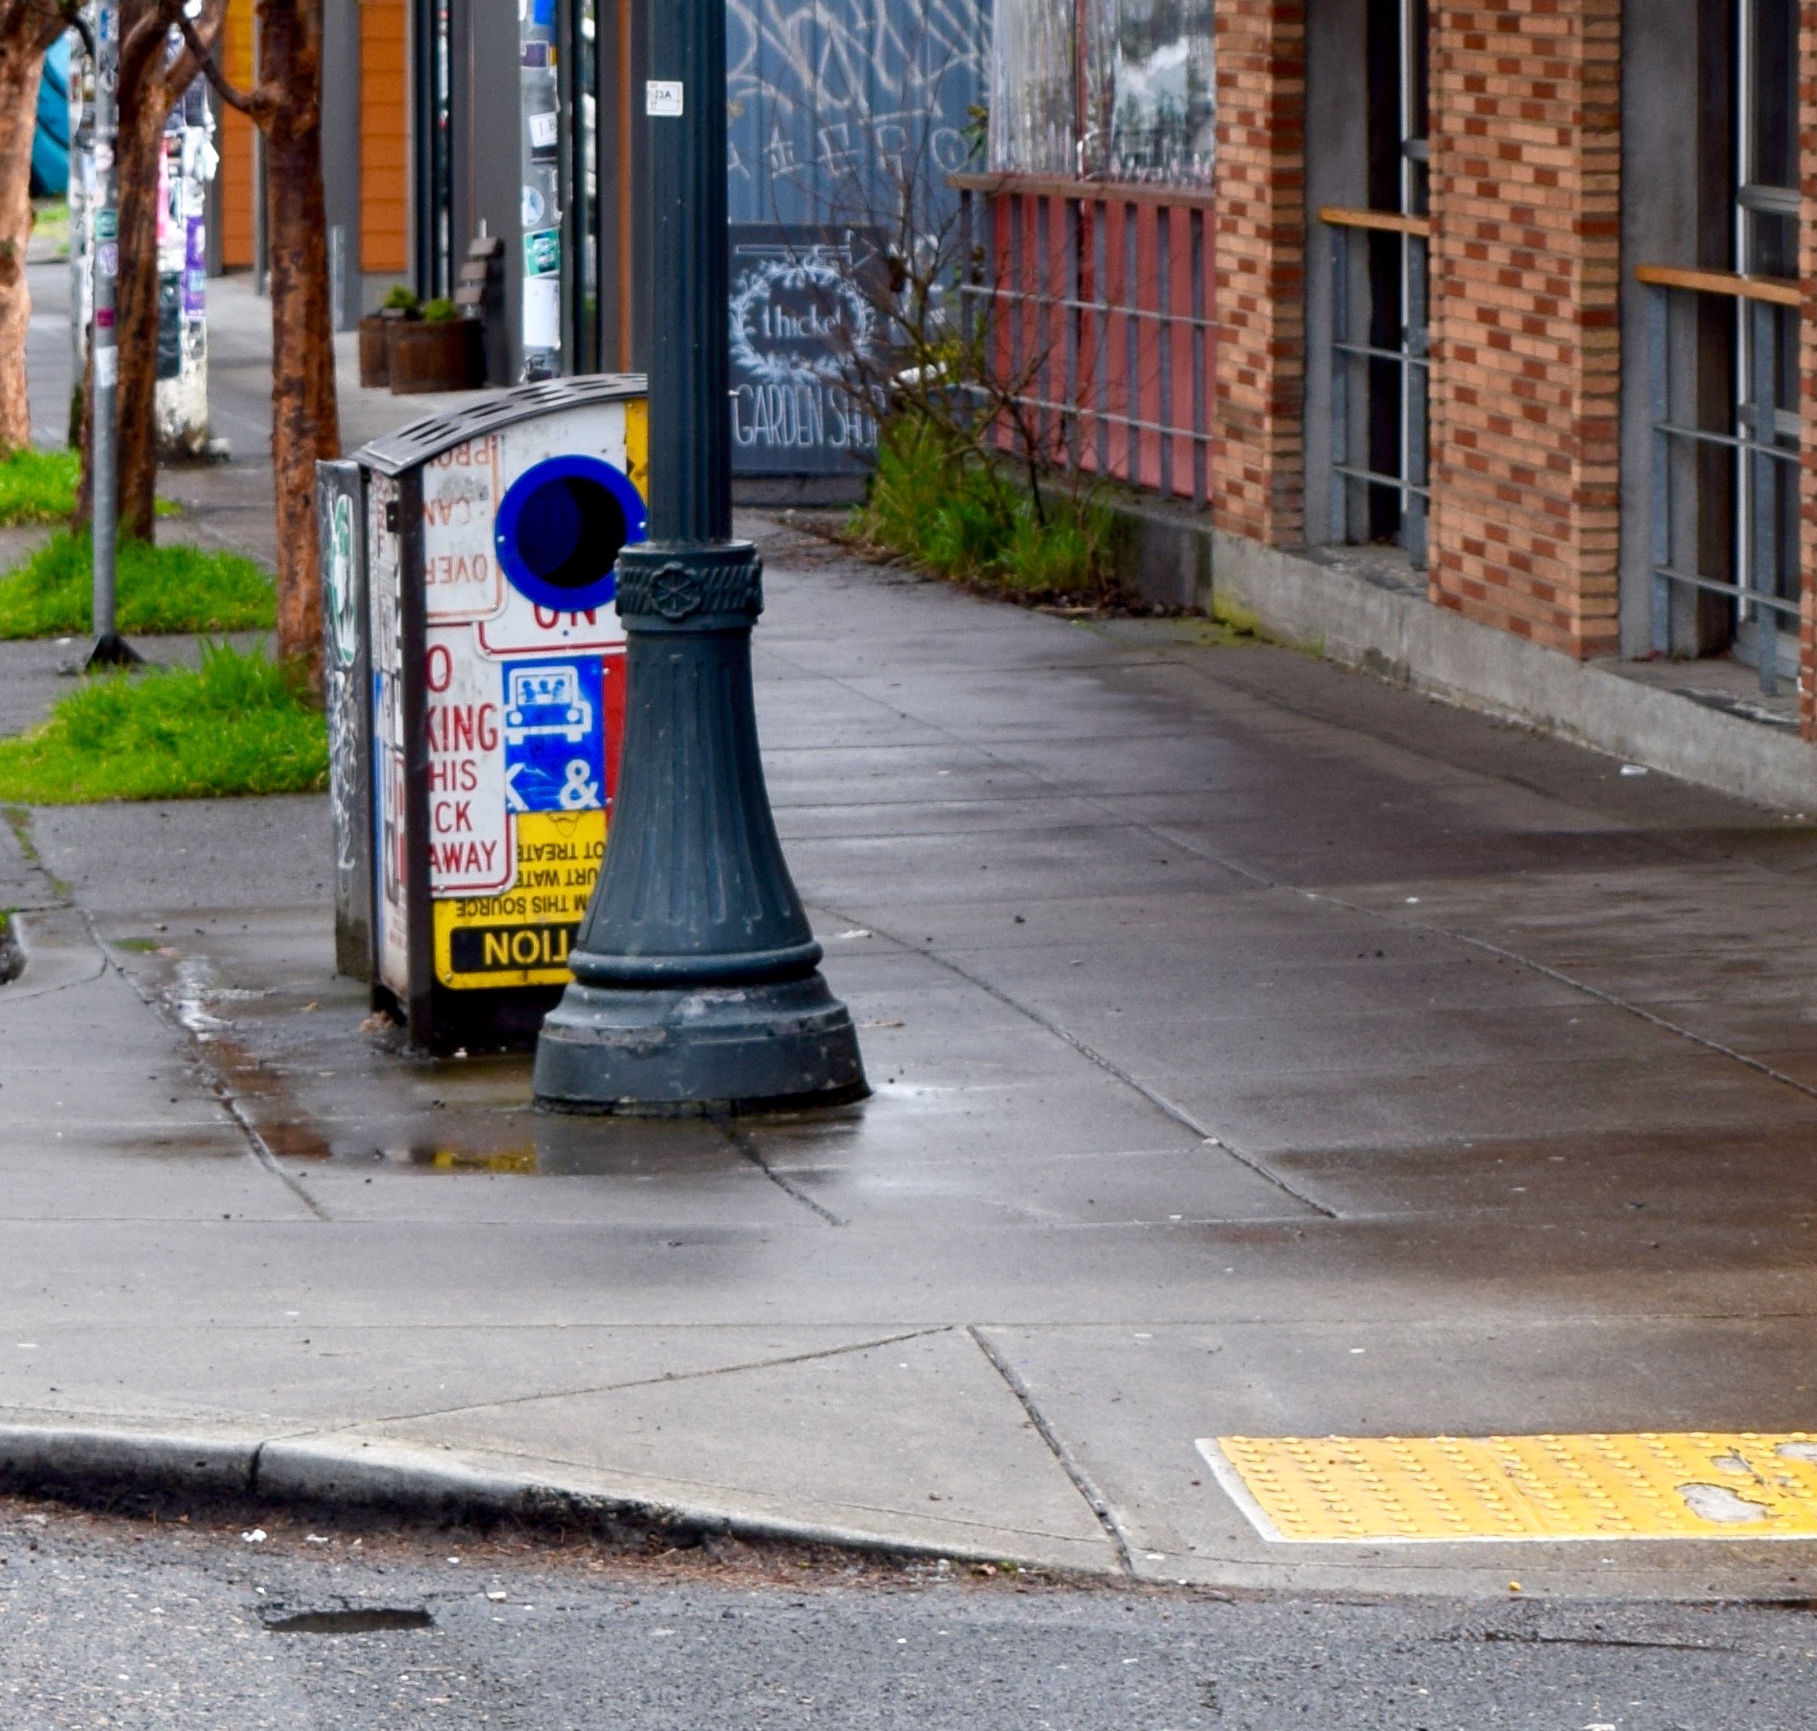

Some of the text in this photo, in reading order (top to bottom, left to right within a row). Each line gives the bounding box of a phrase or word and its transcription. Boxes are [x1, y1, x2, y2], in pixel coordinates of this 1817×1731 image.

[731, 383, 824, 448] GARDEN
[428, 758, 478, 792] HIS
[456, 896, 527, 917] SOURCE
[532, 894, 568, 913] THIS
[485, 929, 568, 965] TION
